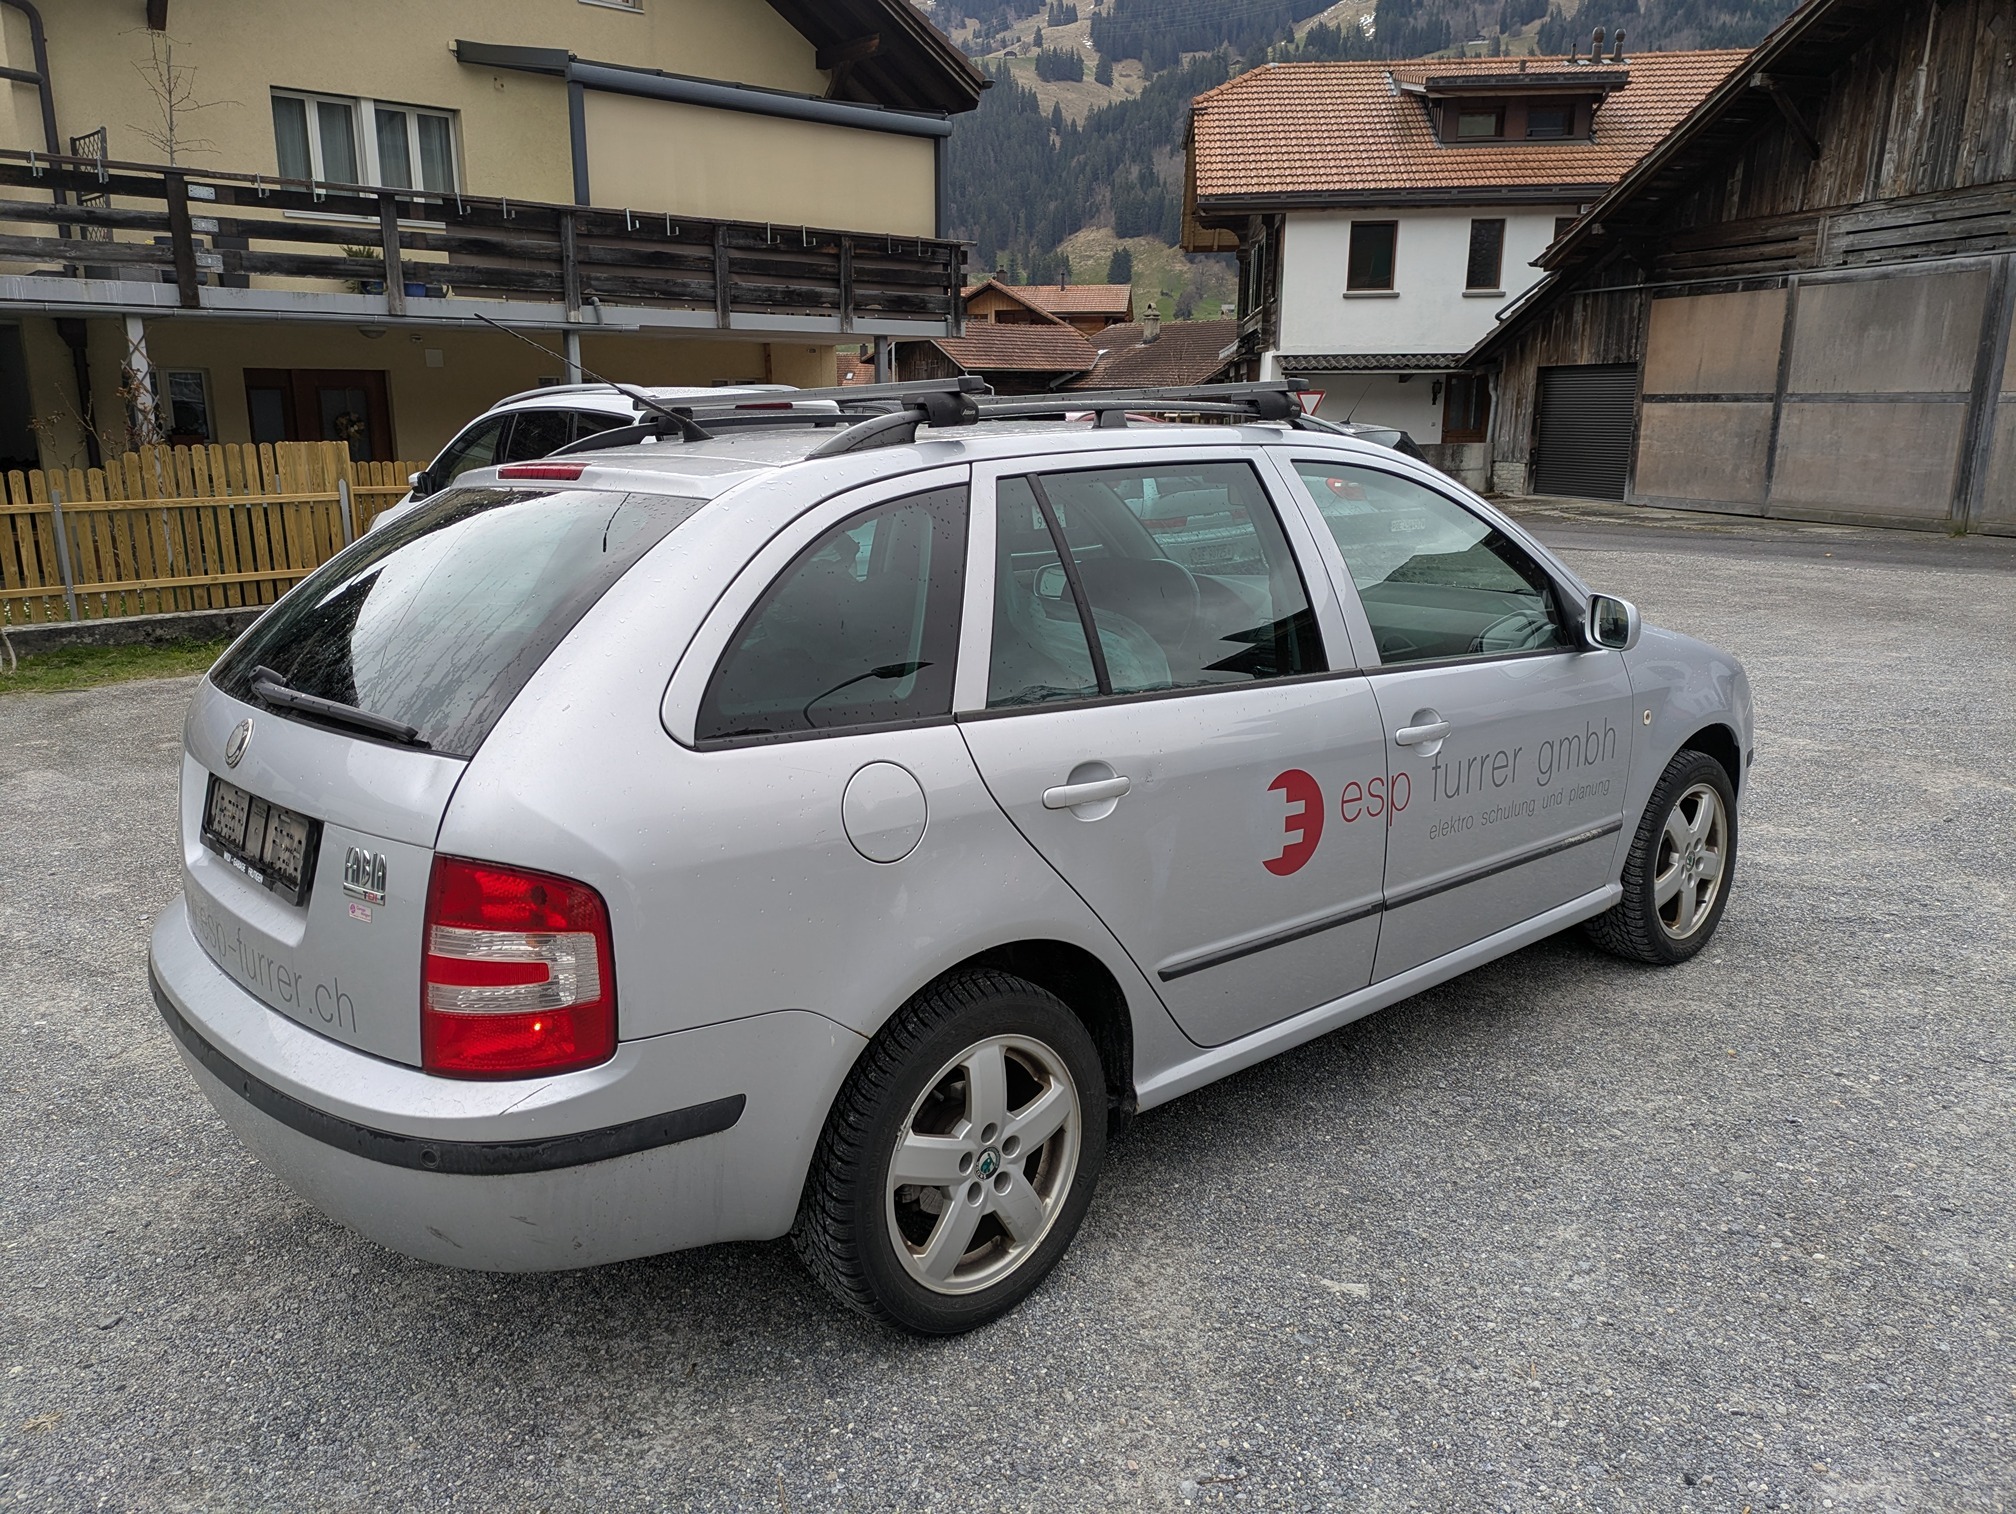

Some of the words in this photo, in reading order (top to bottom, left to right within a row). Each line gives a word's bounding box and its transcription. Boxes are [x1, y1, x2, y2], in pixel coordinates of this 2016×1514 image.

[1340, 771, 1412, 827] esp
[1431, 750, 1523, 802] furrer
[1536, 716, 1616, 787] gmbh
[1429, 814, 1475, 840] elektro
[1481, 799, 1537, 826] schulung
[1542, 787, 1564, 810] und
[1568, 778, 1611, 806] planung
[344, 846, 387, 892] FABIA
